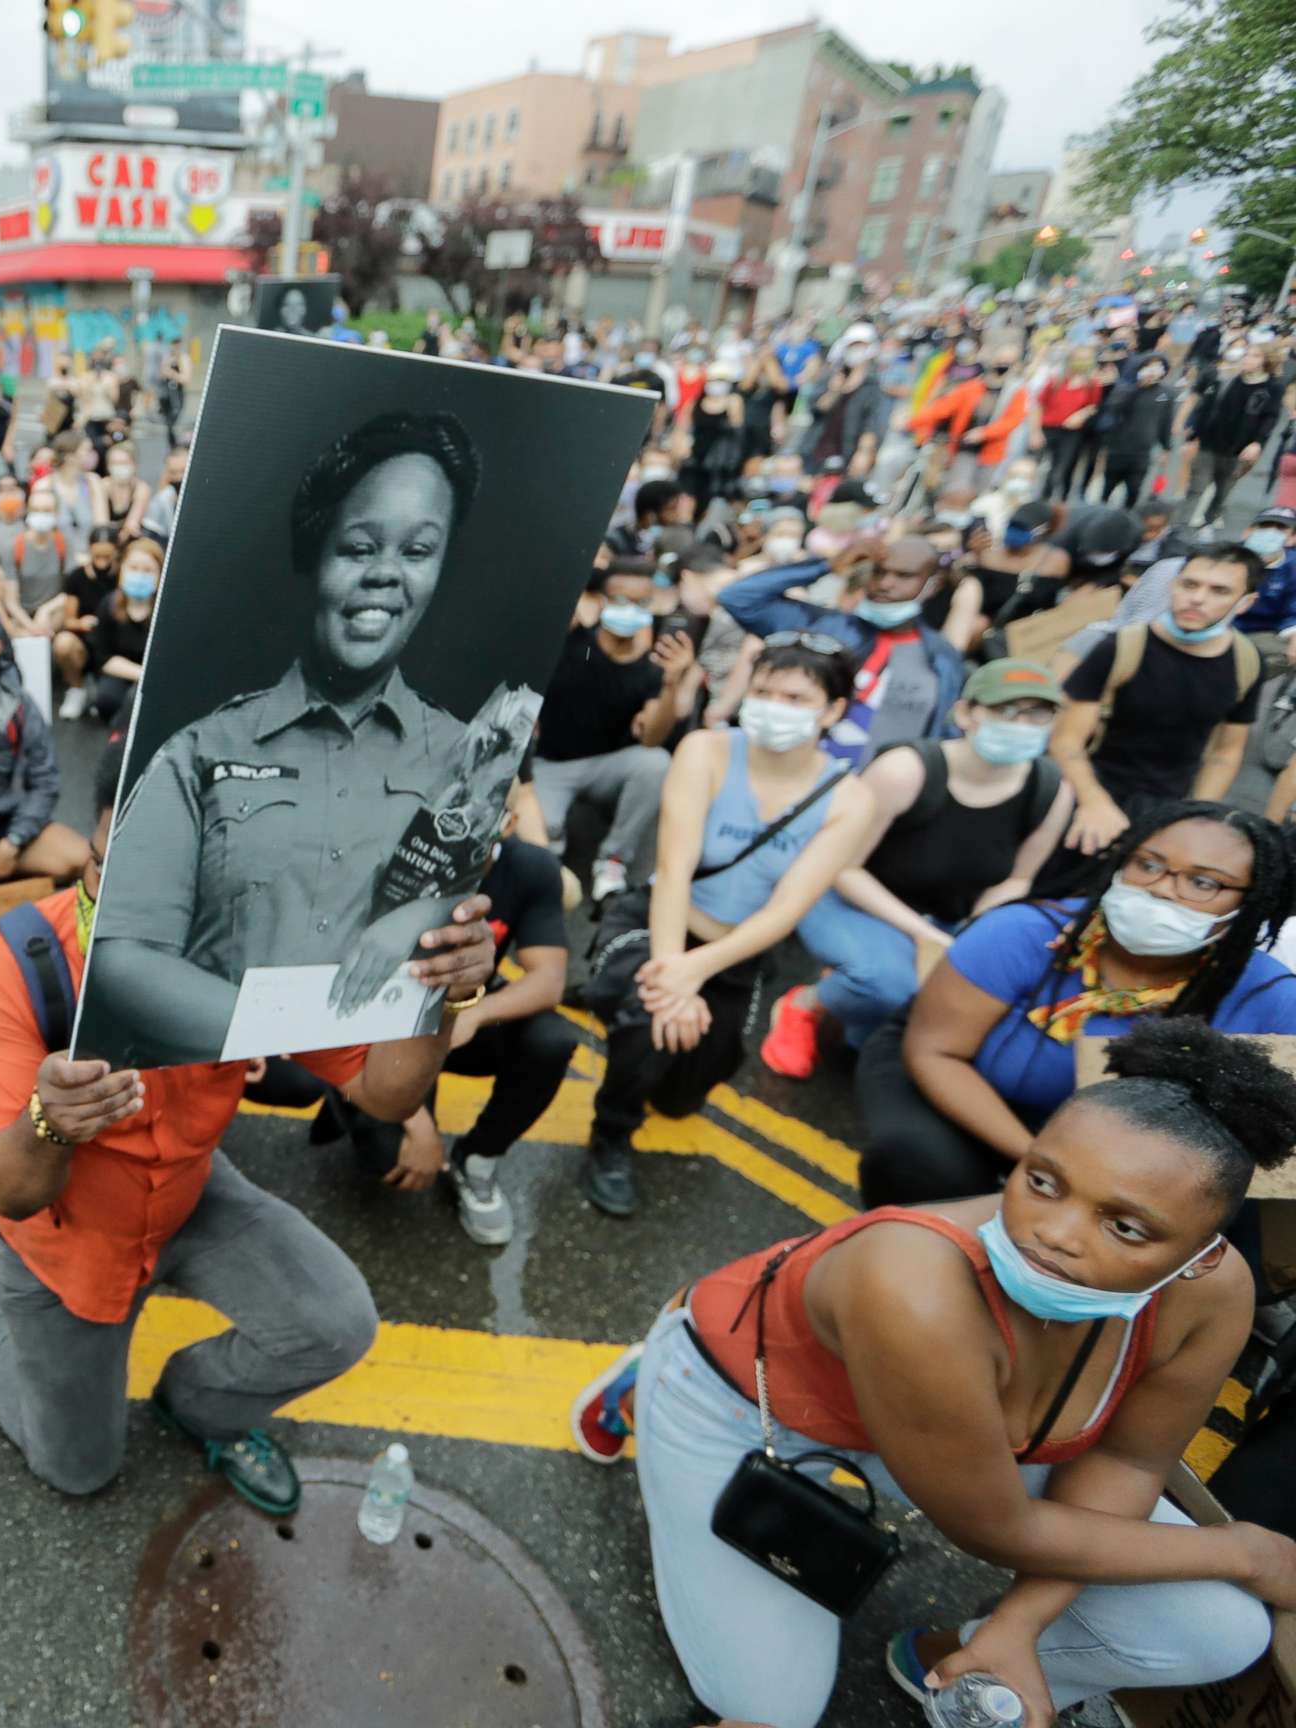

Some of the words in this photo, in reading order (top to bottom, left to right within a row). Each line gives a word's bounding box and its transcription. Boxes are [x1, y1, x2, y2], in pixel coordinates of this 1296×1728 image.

[87, 153, 157, 189] CAR
[76, 194, 169, 228] WASH
[230, 764, 282, 780] TAYLOR
